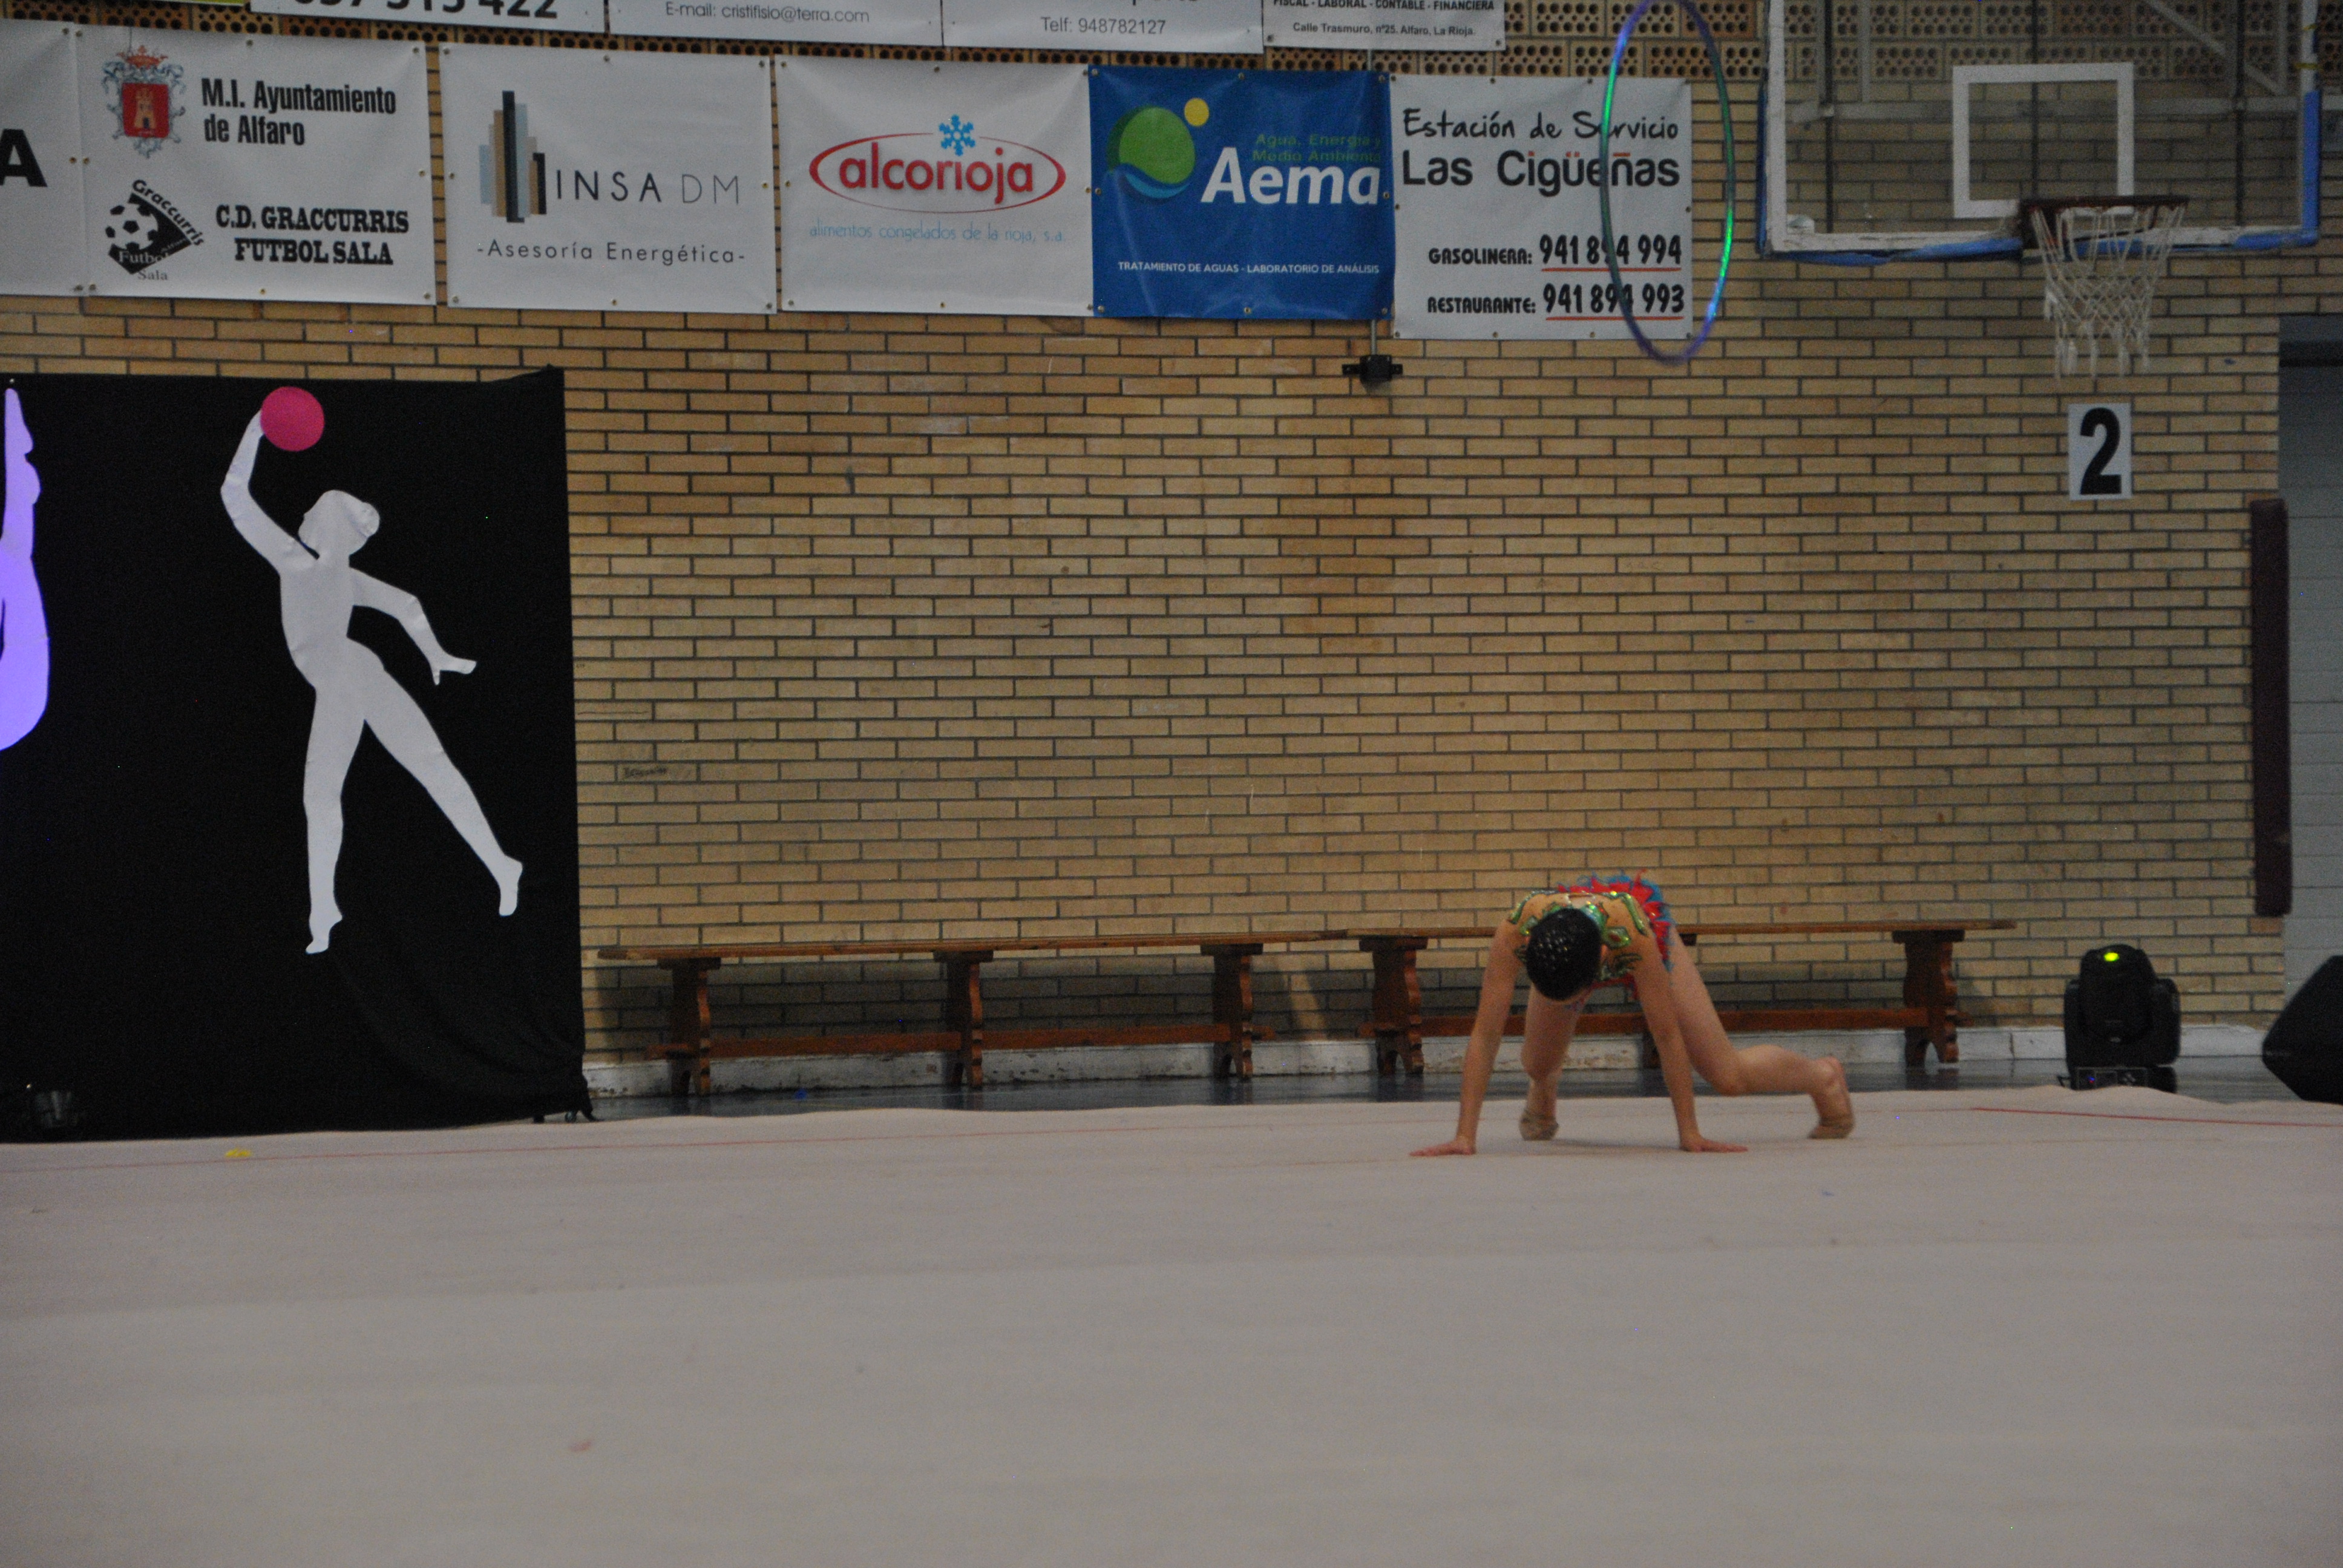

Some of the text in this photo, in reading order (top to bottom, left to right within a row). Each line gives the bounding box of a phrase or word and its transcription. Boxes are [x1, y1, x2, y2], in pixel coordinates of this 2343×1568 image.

[665, 1, 869, 22] E-mail: cristifisio@terra.com
[1376, 0, 1424, 10] CONTABLE
[1434, 0, 1493, 10] FINANCIERA
[1041, 17, 1166, 34] Telf: 948782127
[1293, 22, 1318, 32] Calle
[1321, 23, 1372, 34] Trasmuro,
[1401, 25, 1432, 36] Alfaro,
[202, 78, 396, 114] M.I. Ayuntamiento
[205, 115, 304, 145] de Alfaro
[1403, 108, 1679, 139] Estación de Srvicio
[1252, 150, 1381, 163] Medio Ambiente
[1403, 150, 1473, 186] Las
[557, 170, 739, 204] INSA DM
[839, 142, 1034, 204] alcorioja
[1201, 147, 1380, 205] Aema
[132, 179, 205, 246] Graccurris
[216, 205, 408, 233] C.D. GRACCURRIS
[810, 218, 873, 238] alimentos
[878, 221, 957, 241] congelados
[962, 221, 981, 240] de
[988, 224, 998, 241] la
[235, 238, 393, 265] FUTBOL SALA
[1429, 249, 1532, 264] GASOLINERA:
[1539, 235, 1578, 264] 941
[1637, 235, 1681, 264] 994
[137, 270, 169, 281] Sala
[1118, 262, 1186, 272] TRATAMIENTO
[1188, 264, 1201, 272] DE
[1204, 264, 1239, 273] AGUAS
[1247, 264, 1319, 273] LABORATORIO
[1321, 264, 1334, 273] DE
[1337, 263, 1380, 274] ANÁLISIS
[1428, 297, 1535, 313] RESTAURANTE:
[1543, 283, 1582, 313] 941
[1642, 284, 1684, 313] 993
[2080, 408, 2122, 495] 2
